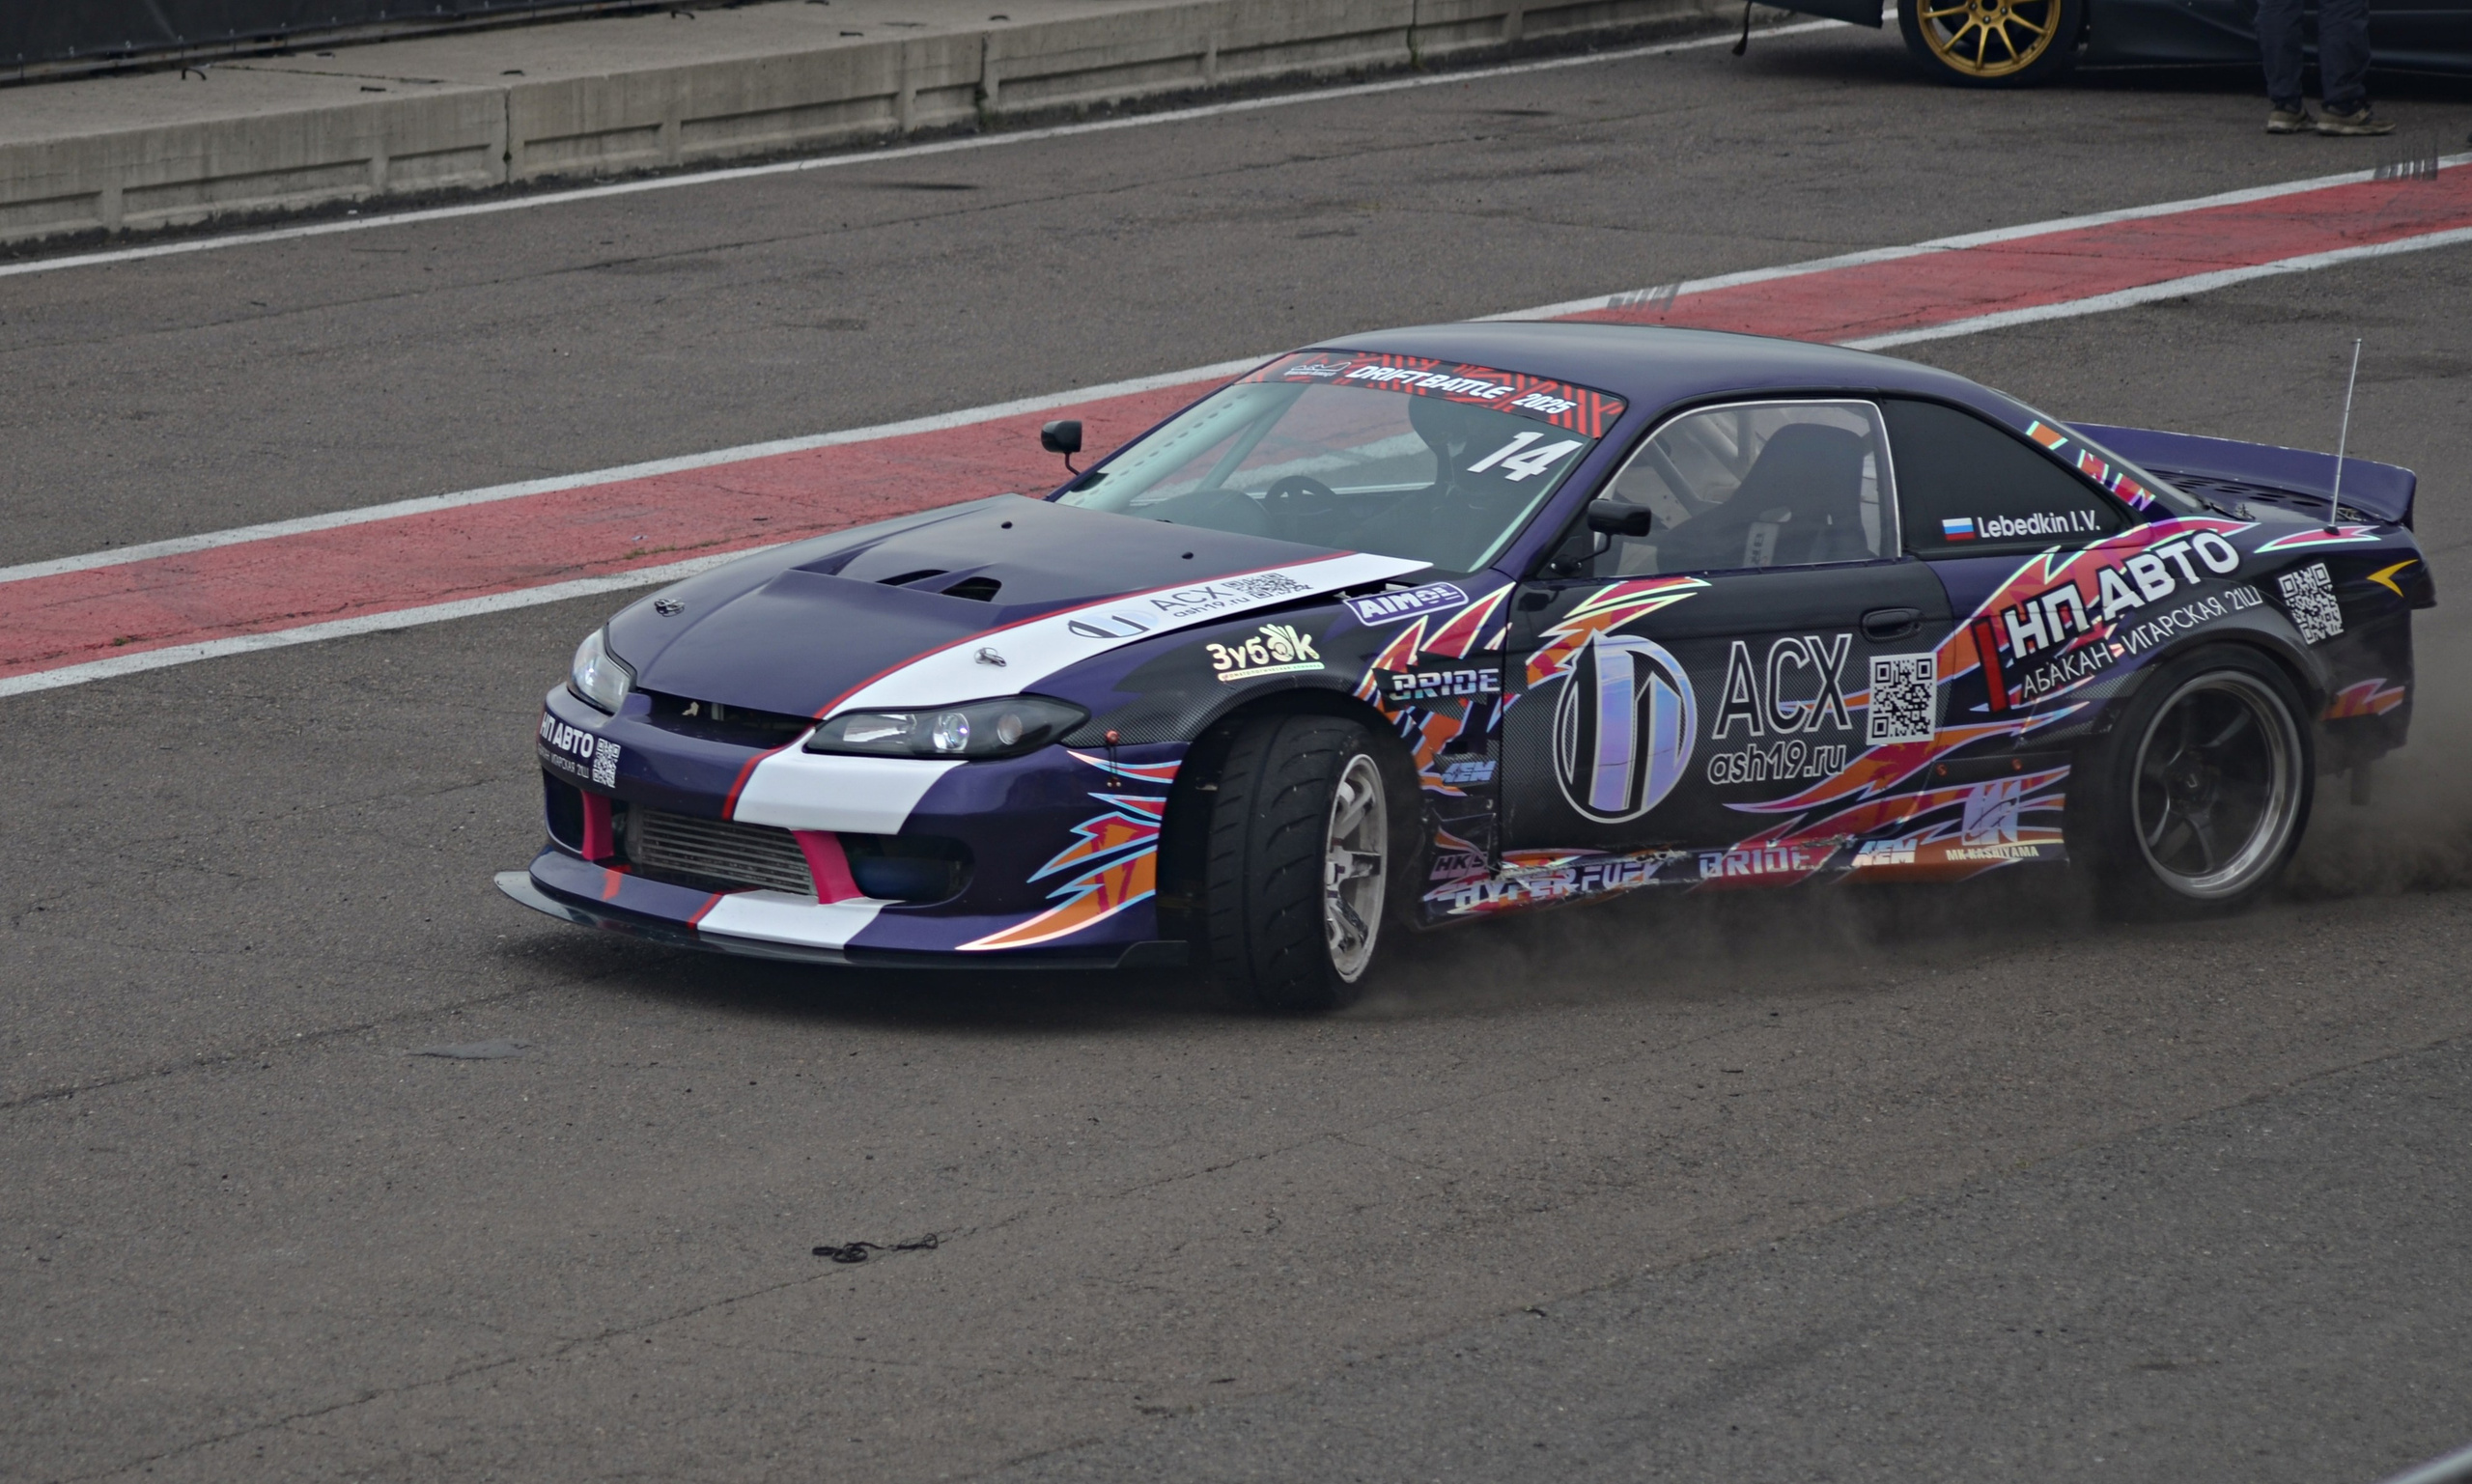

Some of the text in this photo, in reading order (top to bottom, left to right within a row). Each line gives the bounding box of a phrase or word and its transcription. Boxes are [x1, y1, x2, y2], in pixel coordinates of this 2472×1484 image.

[1512, 393, 1577, 413] 2025
[1467, 432, 1584, 482] 14
[1977, 510, 2101, 538] Lebedkin I.V.
[1173, 596, 1251, 618] ash19.ru
[1357, 585, 1461, 619] AIMOL
[2004, 532, 2239, 658] НП АВТО
[2024, 585, 2263, 698] АБАКАН ИГАРСКАЯ 21Ш
[1390, 668, 1501, 700] BRIDE
[552, 722, 595, 758] АВТО
[1707, 740, 1847, 785] ash19.ru
[1700, 846, 1812, 879] BRIDE
